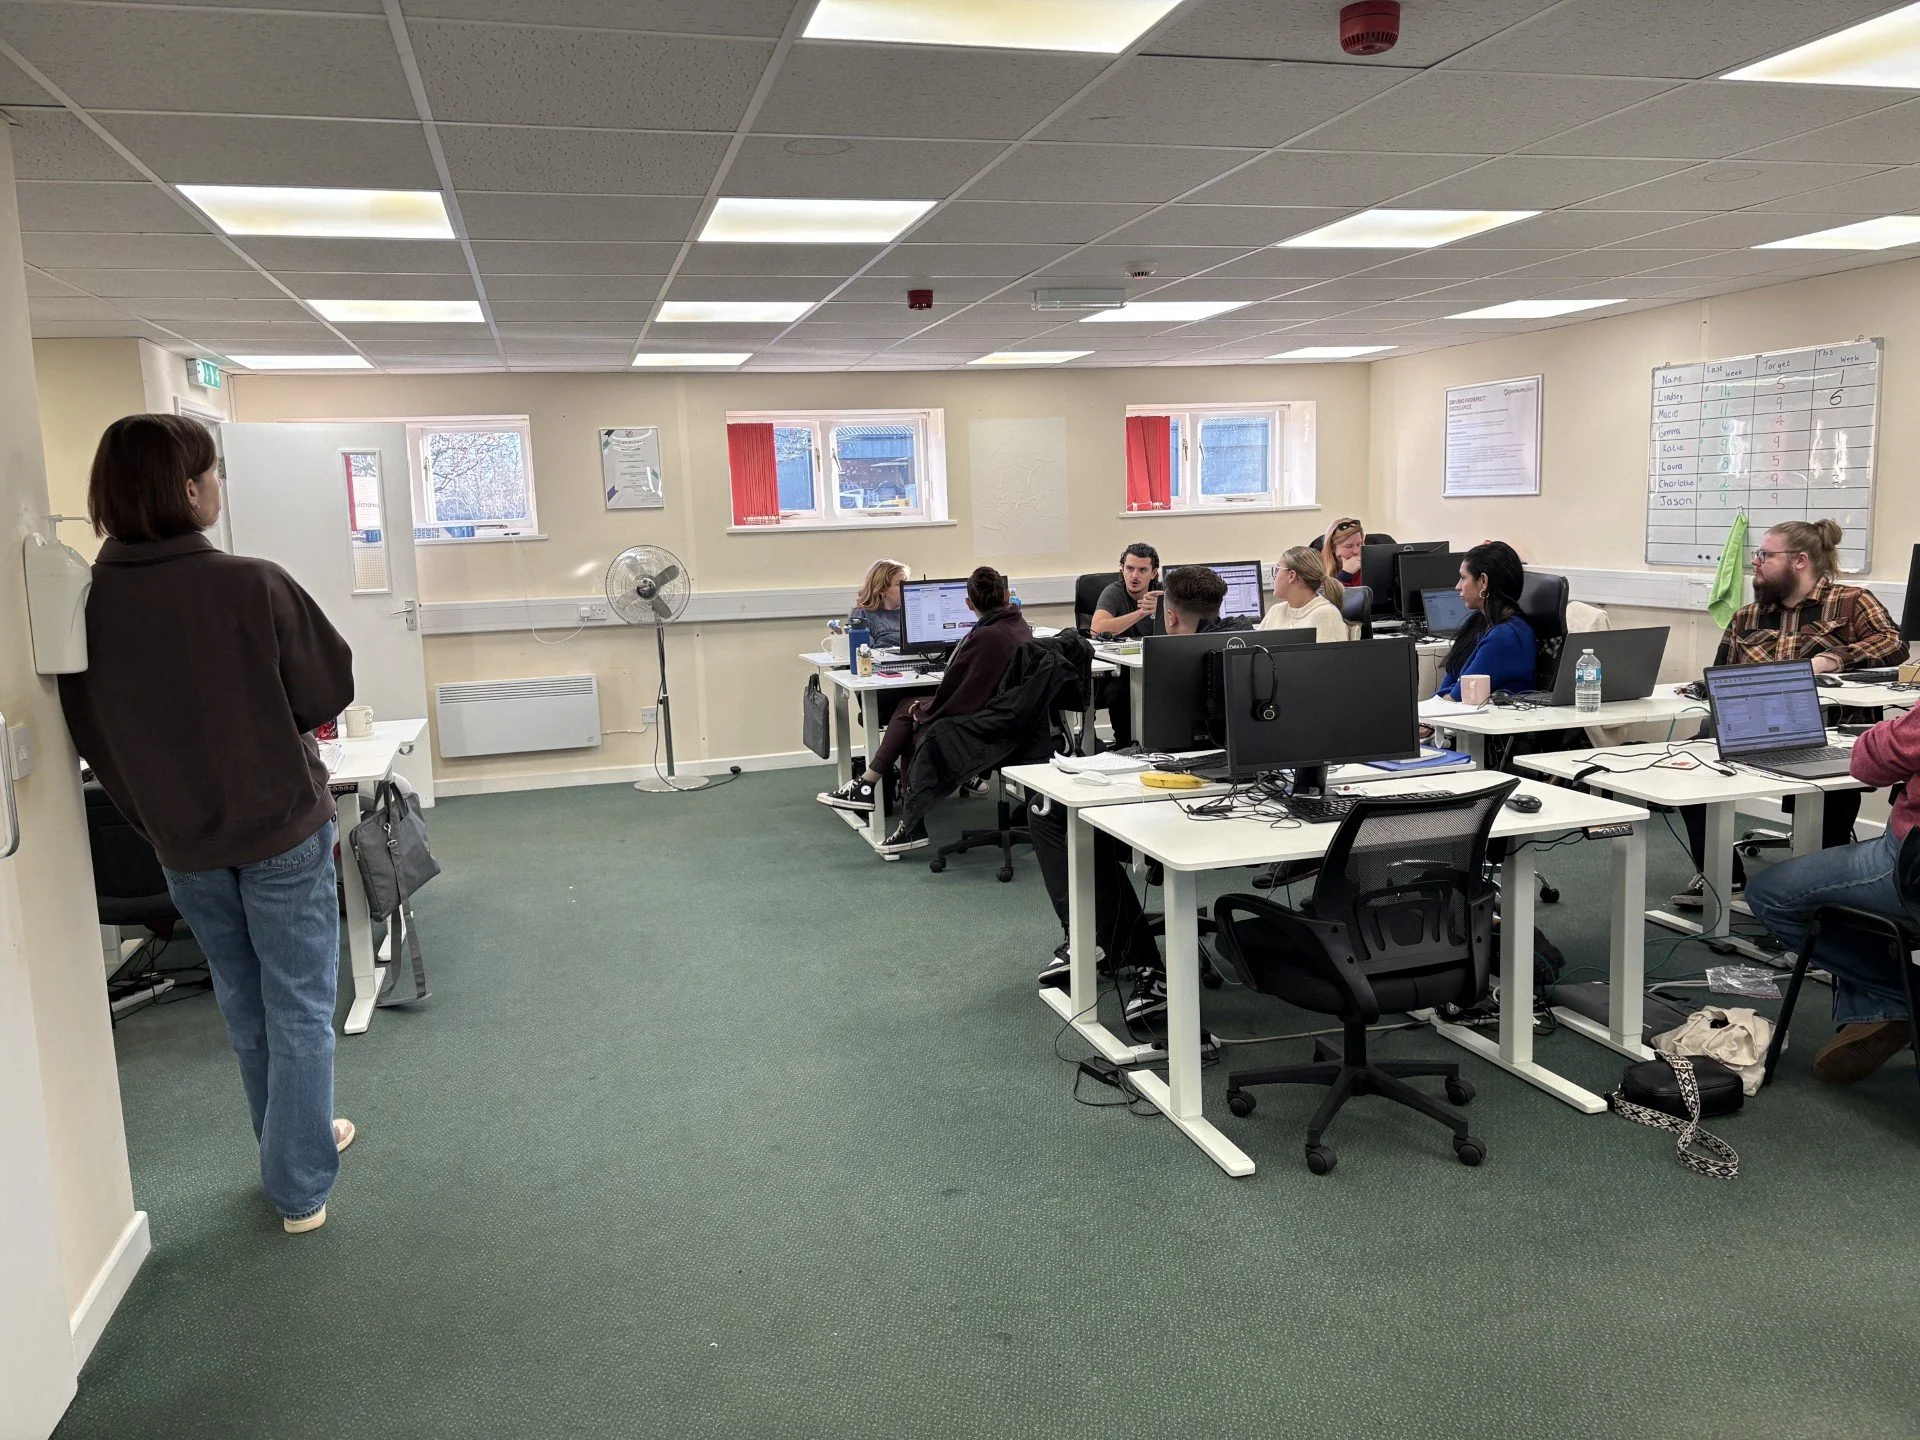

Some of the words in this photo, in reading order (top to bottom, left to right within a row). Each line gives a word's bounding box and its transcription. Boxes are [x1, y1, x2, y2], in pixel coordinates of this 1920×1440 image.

[1817, 349, 1834, 358] This
[1706, 364, 1723, 373] Last
[1763, 359, 1791, 373] Target
[1657, 389, 1684, 403] Lindsey
[1829, 388, 1844, 406] 6
[1658, 424, 1681, 438] Gemma
[1661, 461, 1683, 471] Laura
[1658, 479, 1695, 489] Charlotte
[1659, 495, 1692, 506] Jason
